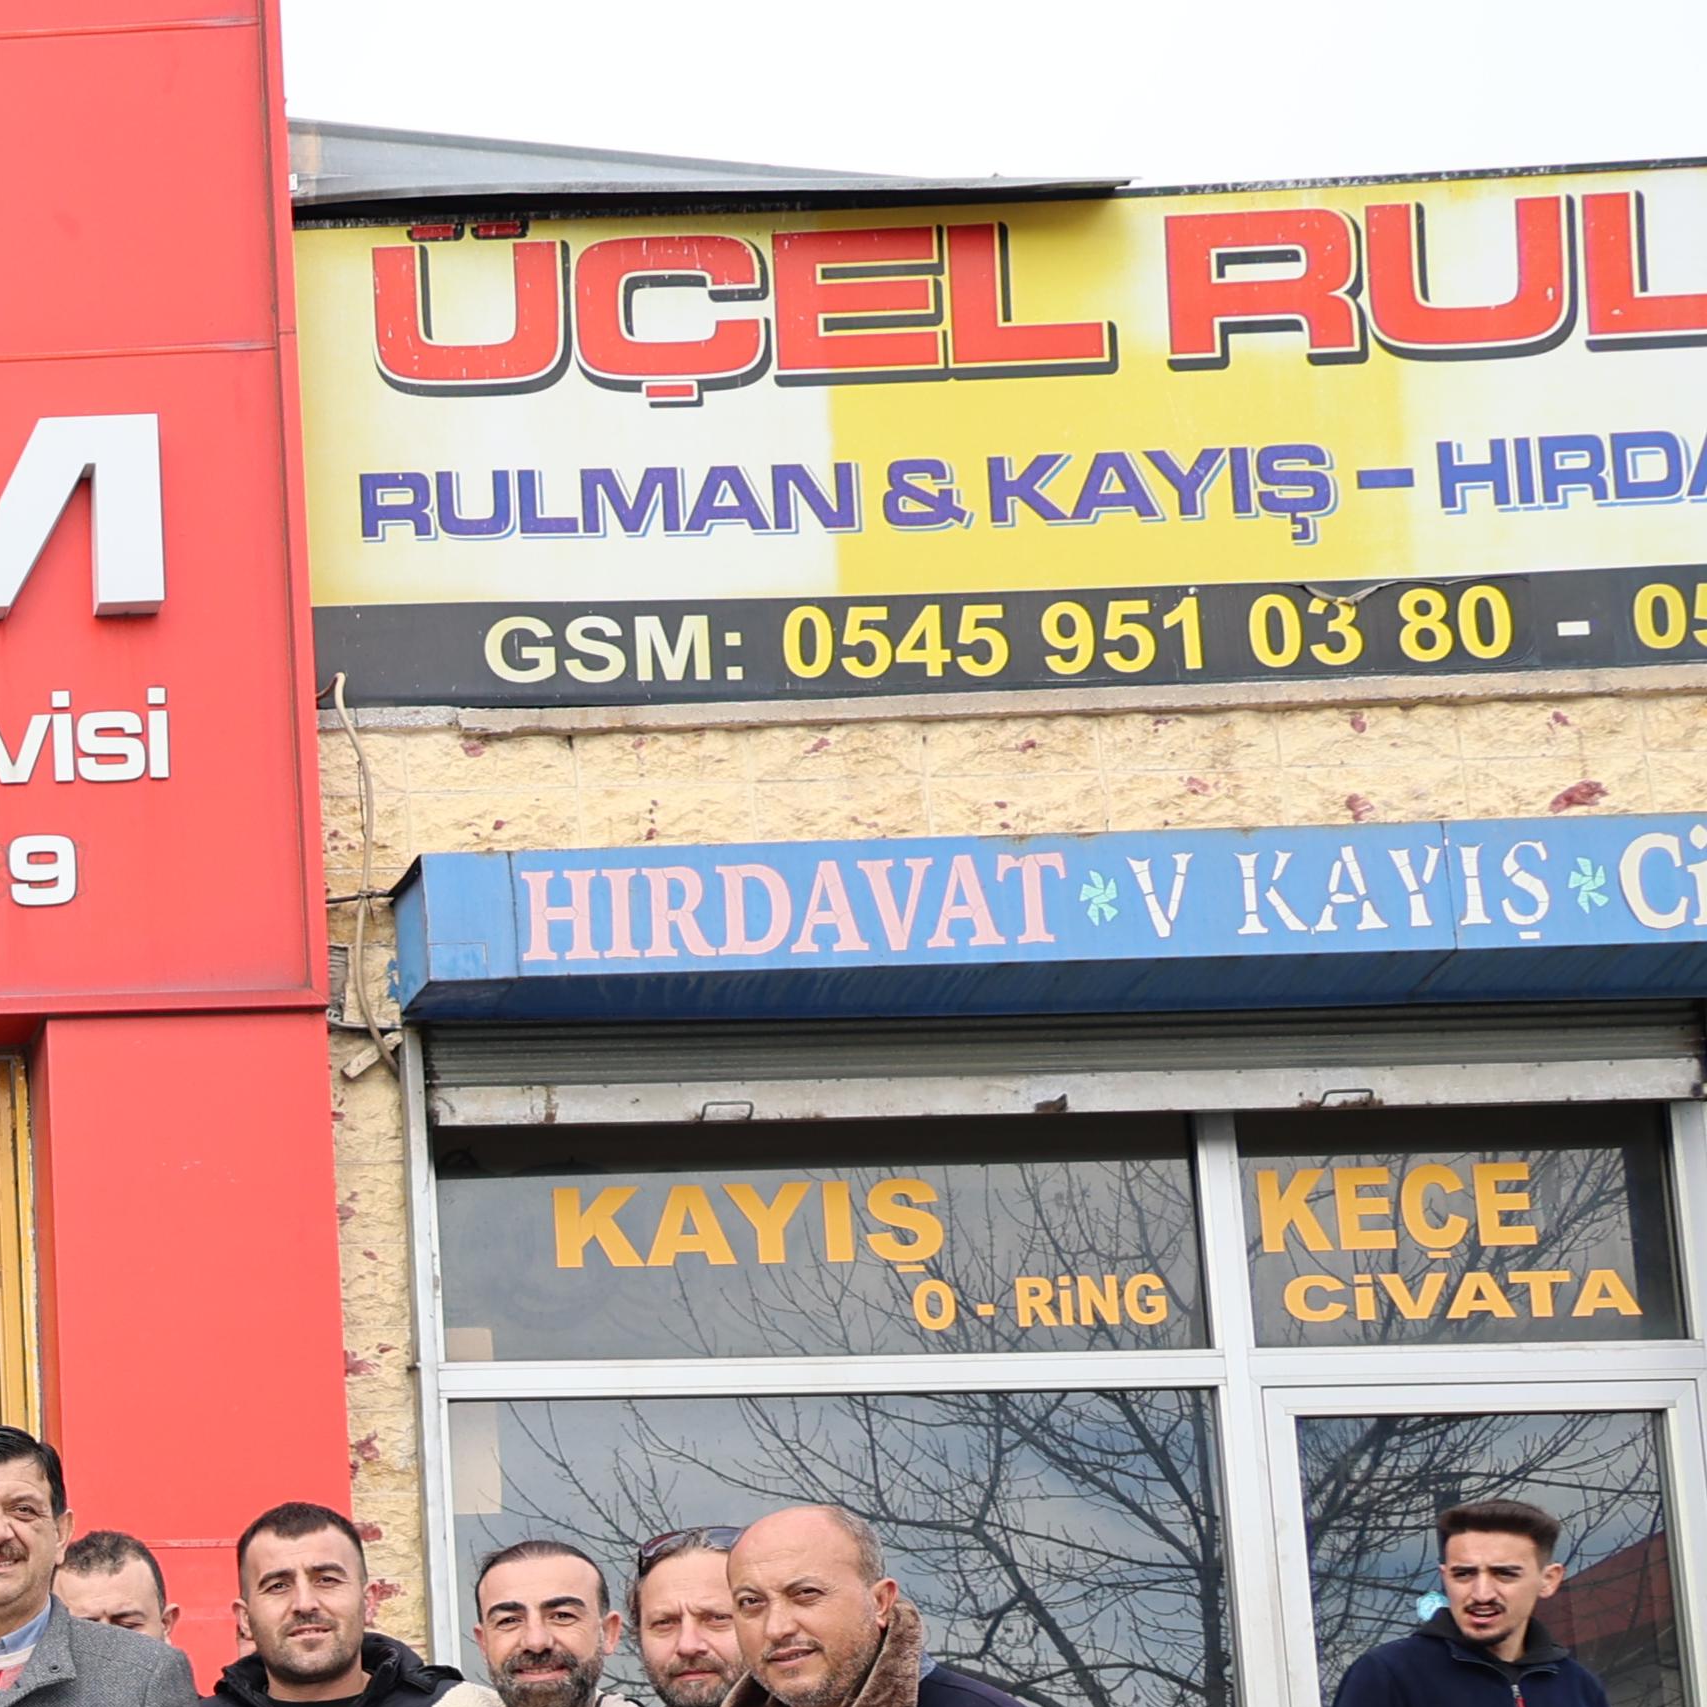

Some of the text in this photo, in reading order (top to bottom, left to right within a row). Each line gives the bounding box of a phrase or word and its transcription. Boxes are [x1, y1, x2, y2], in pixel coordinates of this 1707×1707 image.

[371, 189, 1707, 409] ÜÇEL RUL
[359, 461, 863, 544] RULMAN
[882, 458, 975, 532] &
[986, 443, 1340, 545] KAYIŞ
[485, 614, 745, 684] GSM:
[782, 604, 1010, 680] 0545
[1042, 595, 1204, 677] 951
[1248, 593, 1365, 668] 03
[1398, 584, 1513, 662] 80
[1633, 582, 1707, 650] 0
[520, 851, 1068, 962] HIRDAVAT
[1125, 840, 1550, 941] V KAYIŞ
[1255, 1161, 1539, 1260] KEÇE
